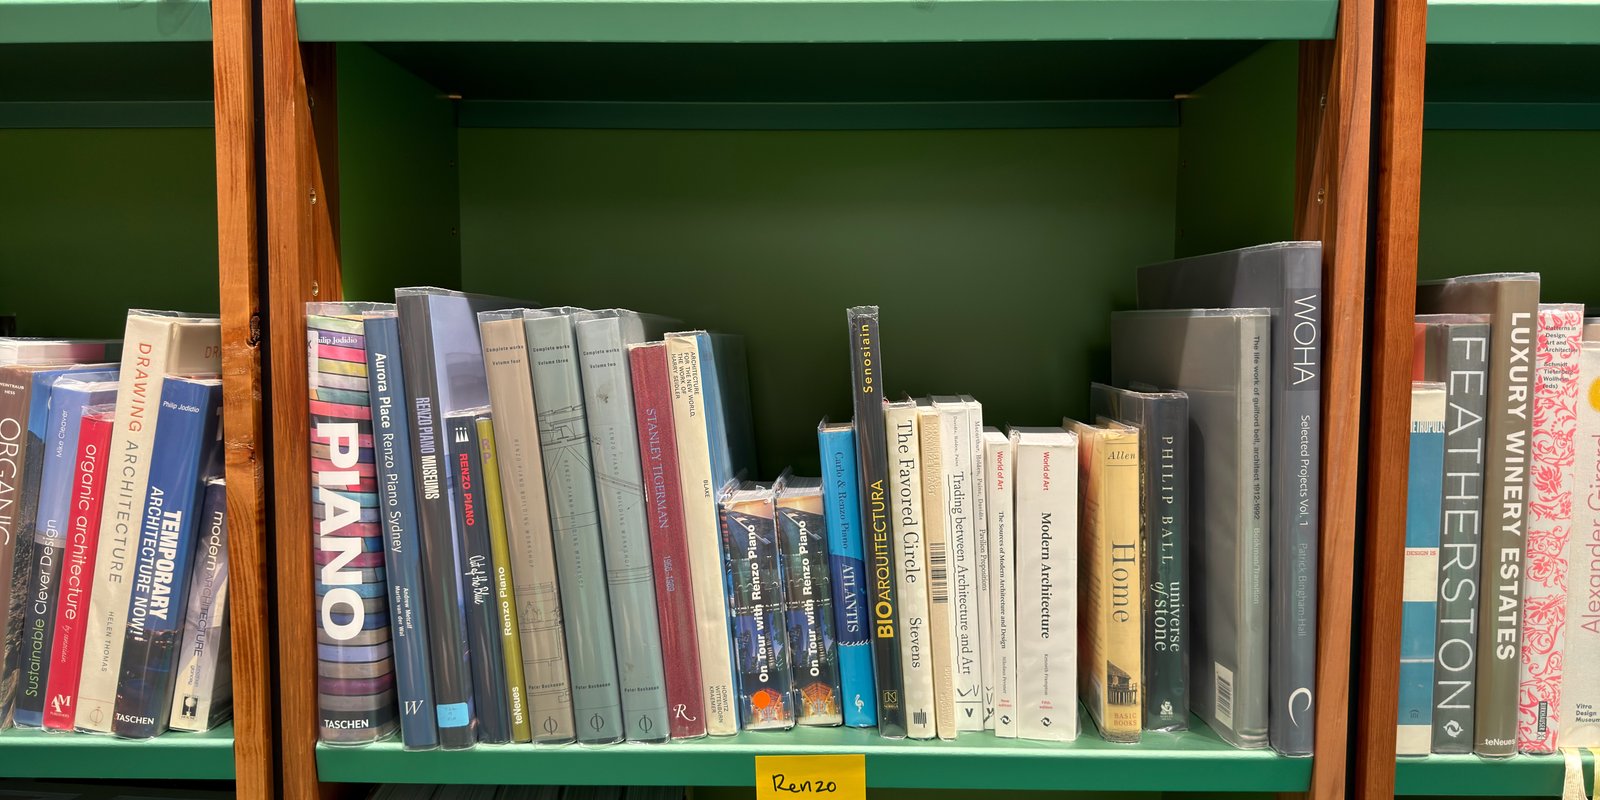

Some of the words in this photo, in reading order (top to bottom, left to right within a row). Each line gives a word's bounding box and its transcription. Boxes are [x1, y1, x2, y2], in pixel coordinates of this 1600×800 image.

[860, 324, 873, 394] Senosiain
[1293, 294, 1316, 385] WOHA
[374, 352, 388, 392] Aurora
[690, 352, 699, 395] ARCHITECTURE
[1507, 312, 1531, 420] LUXURY
[129, 342, 152, 432] DRAWING
[682, 388, 686, 397] OF
[1254, 387, 1260, 396] of
[58, 410, 69, 438] Cleaver
[163, 400, 178, 411] Philip
[178, 404, 200, 414] Jodidio
[379, 396, 392, 429] Place
[416, 397, 433, 426] RENZO
[56, 440, 64, 458] Mike
[382, 433, 394, 469] Renzo
[418, 427, 436, 454] PIANO
[646, 408, 661, 461] STANLEY
[897, 420, 912, 454] The
[1300, 414, 1310, 457] Selected
[460, 452, 471, 492] RENZO
[835, 452, 845, 478] Carlo
[1108, 451, 1136, 460] Allen
[1162, 436, 1173, 504] PHILIP
[80, 444, 98, 511] organic
[386, 473, 399, 506] Piano
[421, 455, 440, 500] MUSEUMS
[653, 464, 669, 528] TIGERMAN
[836, 480, 846, 488] &
[899, 458, 918, 528] Favored
[951, 471, 964, 514] Trading
[1298, 459, 1310, 498] Projects
[1502, 430, 1525, 536] WINERY
[109, 440, 139, 584] ARCHITECTURE
[464, 492, 475, 526] PIANO
[838, 489, 847, 521] Renzo
[1300, 498, 1309, 518] Vol.
[1437, 337, 1486, 709] FEATHERSTON
[40, 519, 59, 567] Design
[136, 486, 164, 594] ARCHITECTURE
[206, 511, 225, 572] modern
[316, 422, 365, 640] PIANO
[389, 511, 404, 554] Sydney
[748, 524, 758, 560] Piano
[798, 520, 808, 554] Piano
[841, 522, 850, 552] Piano
[954, 516, 966, 557] between
[1041, 512, 1052, 560] Modern
[1162, 516, 1173, 565] BALL
[66, 514, 89, 620] architecture
[149, 511, 182, 621] TEMPORARY
[802, 558, 812, 596] Renzo
[870, 480, 894, 639] BIOARQUITECTURA
[903, 532, 921, 584] Circle
[979, 554, 988, 591] Propositions
[1297, 543, 1308, 573] Patrick
[34, 569, 51, 615] Clever
[498, 566, 507, 598] Piano
[751, 562, 762, 600] Renzo
[842, 563, 859, 633] ATLANTIS
[958, 565, 970, 631] Architecture
[1112, 540, 1136, 623] Home
[1150, 581, 1169, 598] of
[194, 572, 215, 657] ARCHITECTURE
[504, 601, 512, 636] Renzo
[754, 602, 764, 632] with
[804, 598, 815, 626] with
[1041, 563, 1052, 639] Architecture
[1170, 581, 1185, 652] universe
[1296, 575, 1307, 636] Bingham-Hall
[1496, 548, 1520, 661] ESTATES
[106, 611, 114, 638] HELEN
[808, 628, 818, 656] Tour
[910, 617, 922, 669] Stevens
[960, 634, 972, 654] and
[1154, 599, 1168, 652] stone
[26, 618, 45, 697] Sustainable
[102, 641, 112, 672] THOMAS
[757, 634, 767, 662] Tour
[962, 654, 973, 675] Art
[758, 664, 769, 683] On
[810, 659, 820, 677] On
[116, 713, 155, 726] TASCHEN
[324, 718, 369, 729] TASCHEN
[512, 686, 522, 725] teNeues
[772, 774, 837, 793] Renzo
